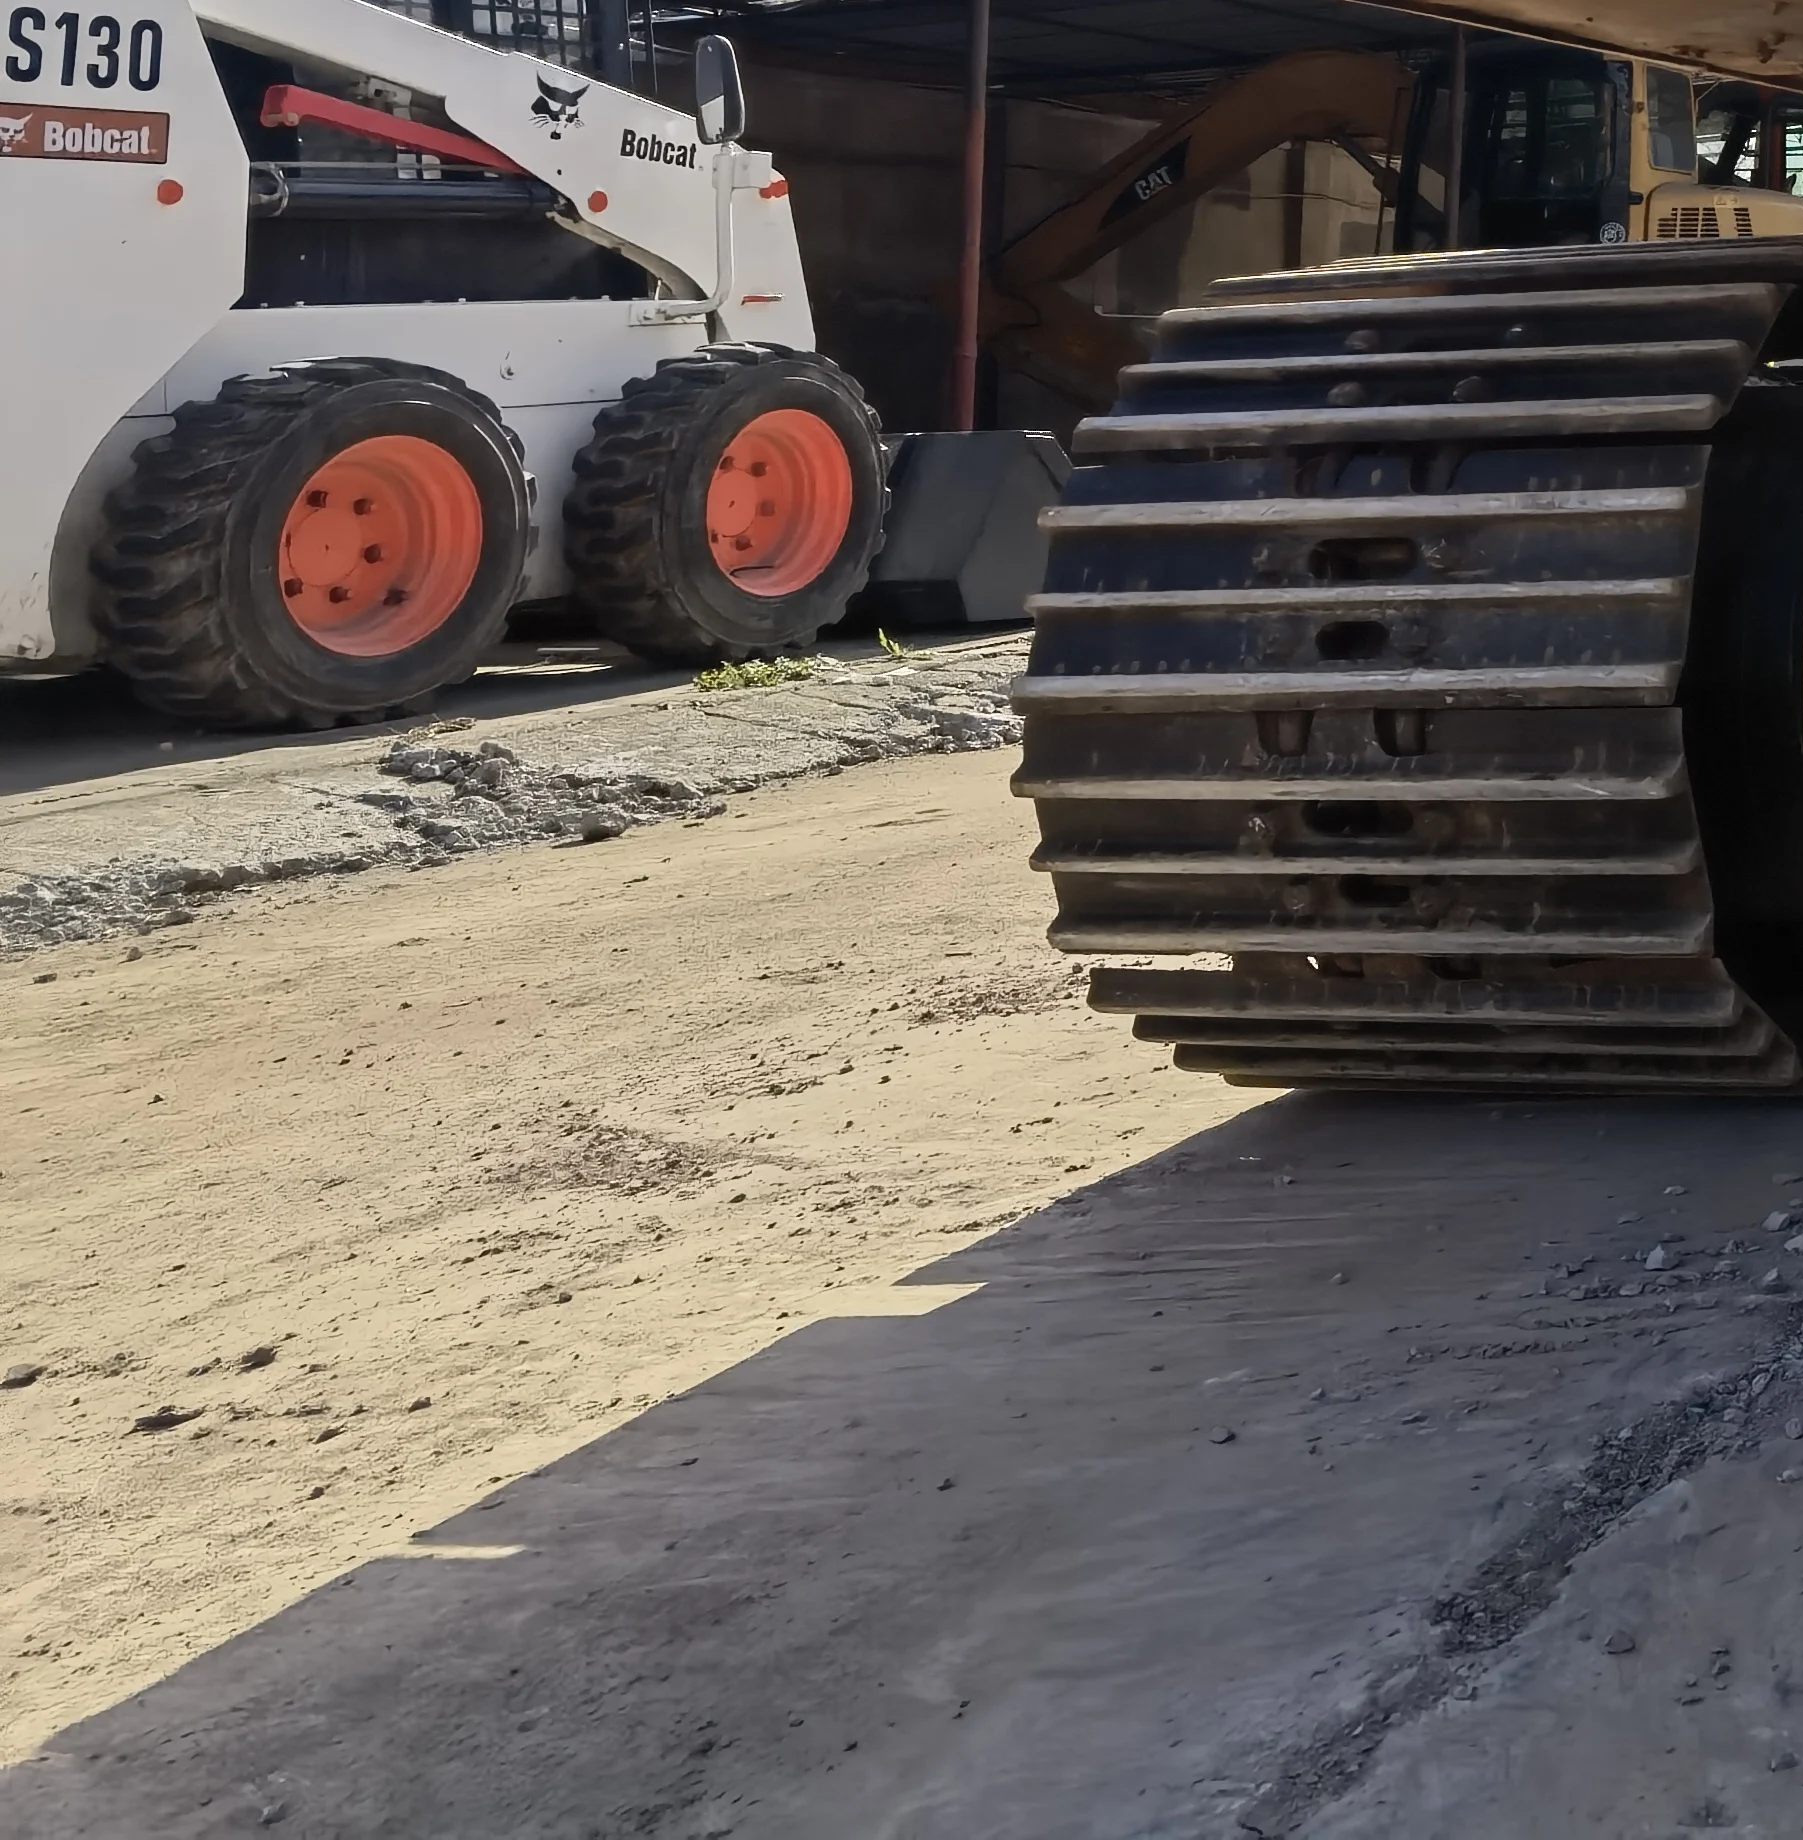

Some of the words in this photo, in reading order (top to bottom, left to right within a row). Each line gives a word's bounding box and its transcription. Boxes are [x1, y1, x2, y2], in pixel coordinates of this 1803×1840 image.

[5, 6, 163, 92] S130
[43, 120, 151, 155] Bobcat
[620, 128, 697, 170] Bobcat
[1134, 166, 1173, 200] CAT
